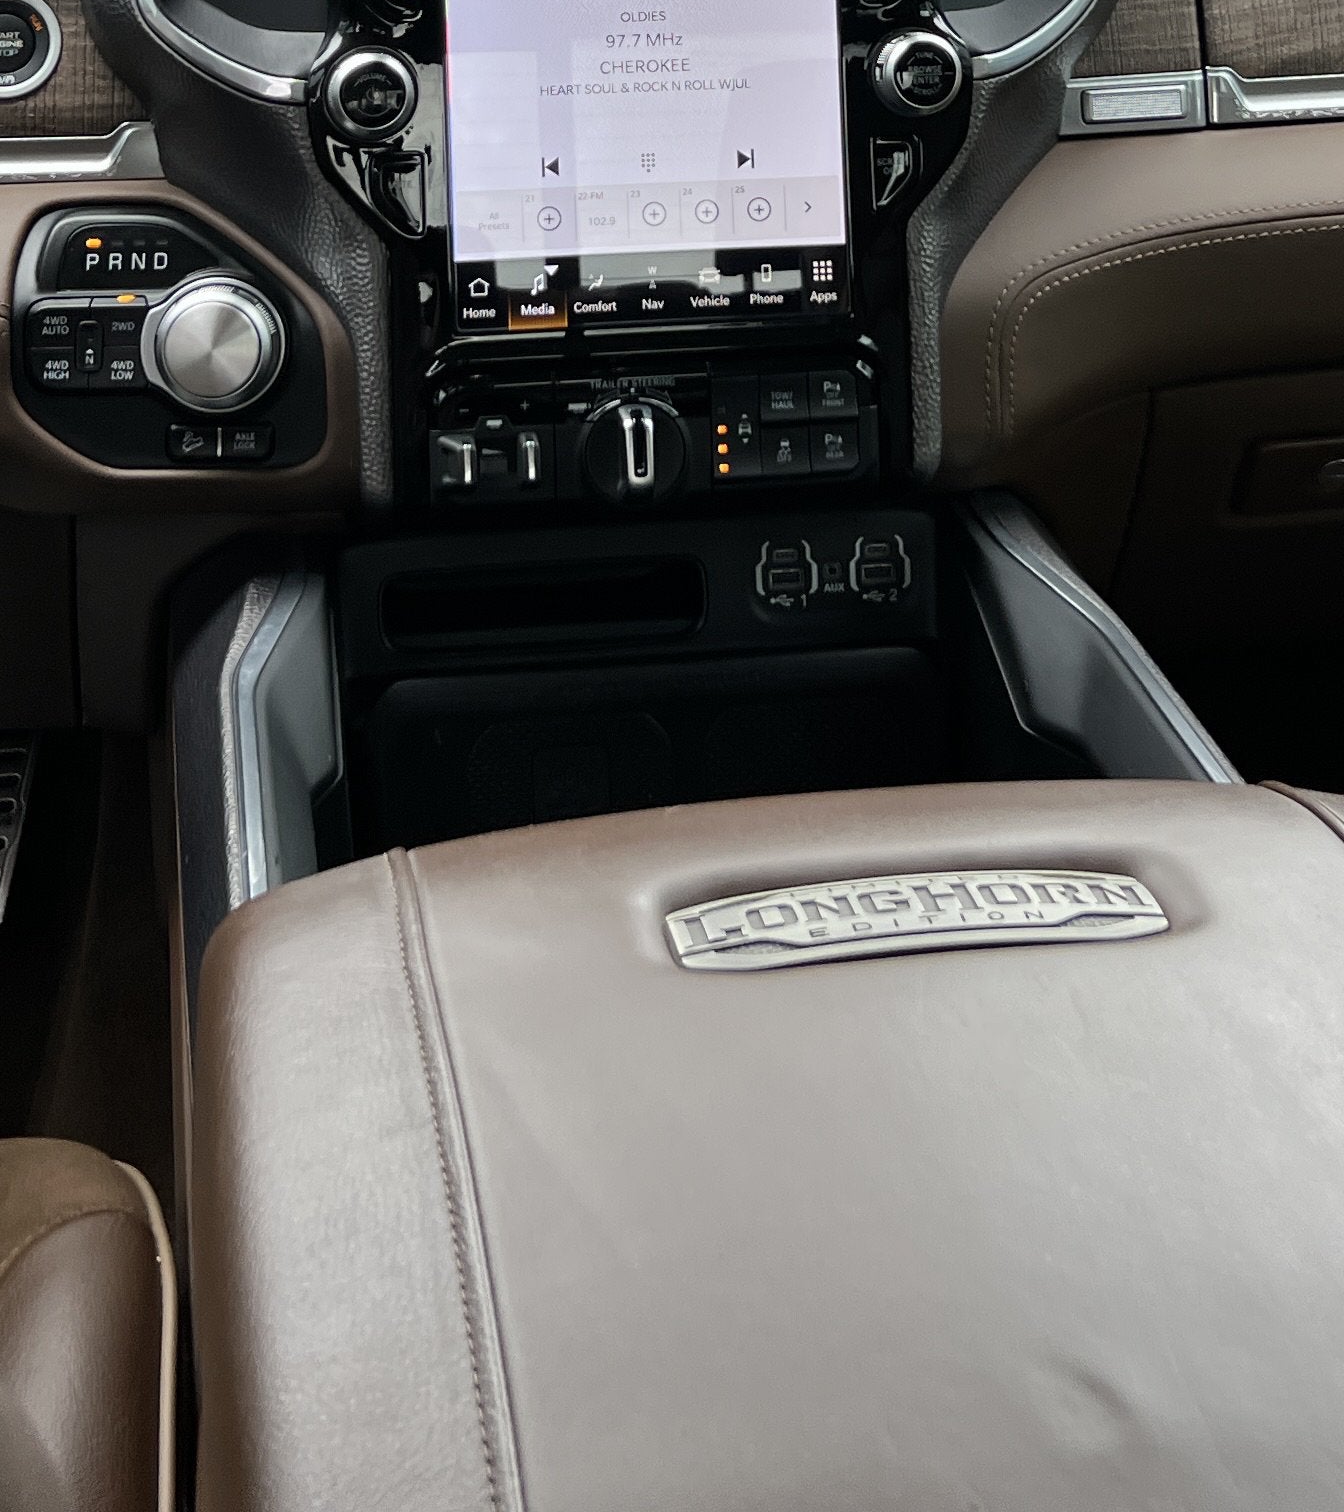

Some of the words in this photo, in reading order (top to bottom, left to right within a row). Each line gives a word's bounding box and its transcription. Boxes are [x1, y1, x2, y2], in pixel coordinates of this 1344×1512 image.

[620, 10, 667, 23] OLDIES
[605, 33, 642, 49] 97.7
[645, 32, 684, 47] MHz
[599, 57, 692, 75] CHEROKEE
[540, 84, 582, 97] HEART
[584, 82, 618, 95] SOUL
[620, 82, 631, 94] &
[633, 81, 670, 93] ROCK
[671, 80, 682, 91] N
[684, 79, 716, 91] ROLL
[718, 77, 751, 92] WJUL
[478, 221, 510, 231] Presets
[588, 216, 617, 227] 102.9
[690, 294, 731, 308] Vehicle
[749, 292, 784, 306] Phone
[809, 290, 839, 303] Apps
[520, 303, 556, 317] Media
[573, 300, 618, 314] Comfort
[641, 298, 665, 311] Nav
[462, 307, 497, 320] Home
[42, 315, 68, 326] 4WD
[111, 321, 136, 332] 2WD
[41, 325, 70, 336] AUTO
[44, 360, 70, 371] 4WD
[84, 354, 95, 365] N
[110, 360, 135, 371] 4WD
[43, 370, 70, 380] HIGH
[110, 370, 135, 381] LOW
[823, 582, 846, 593] AUX
[800, 593, 807, 607] 1
[889, 589, 898, 602] 2
[674, 882, 1154, 949] LONGHORN
[809, 909, 1045, 938] EDITION
